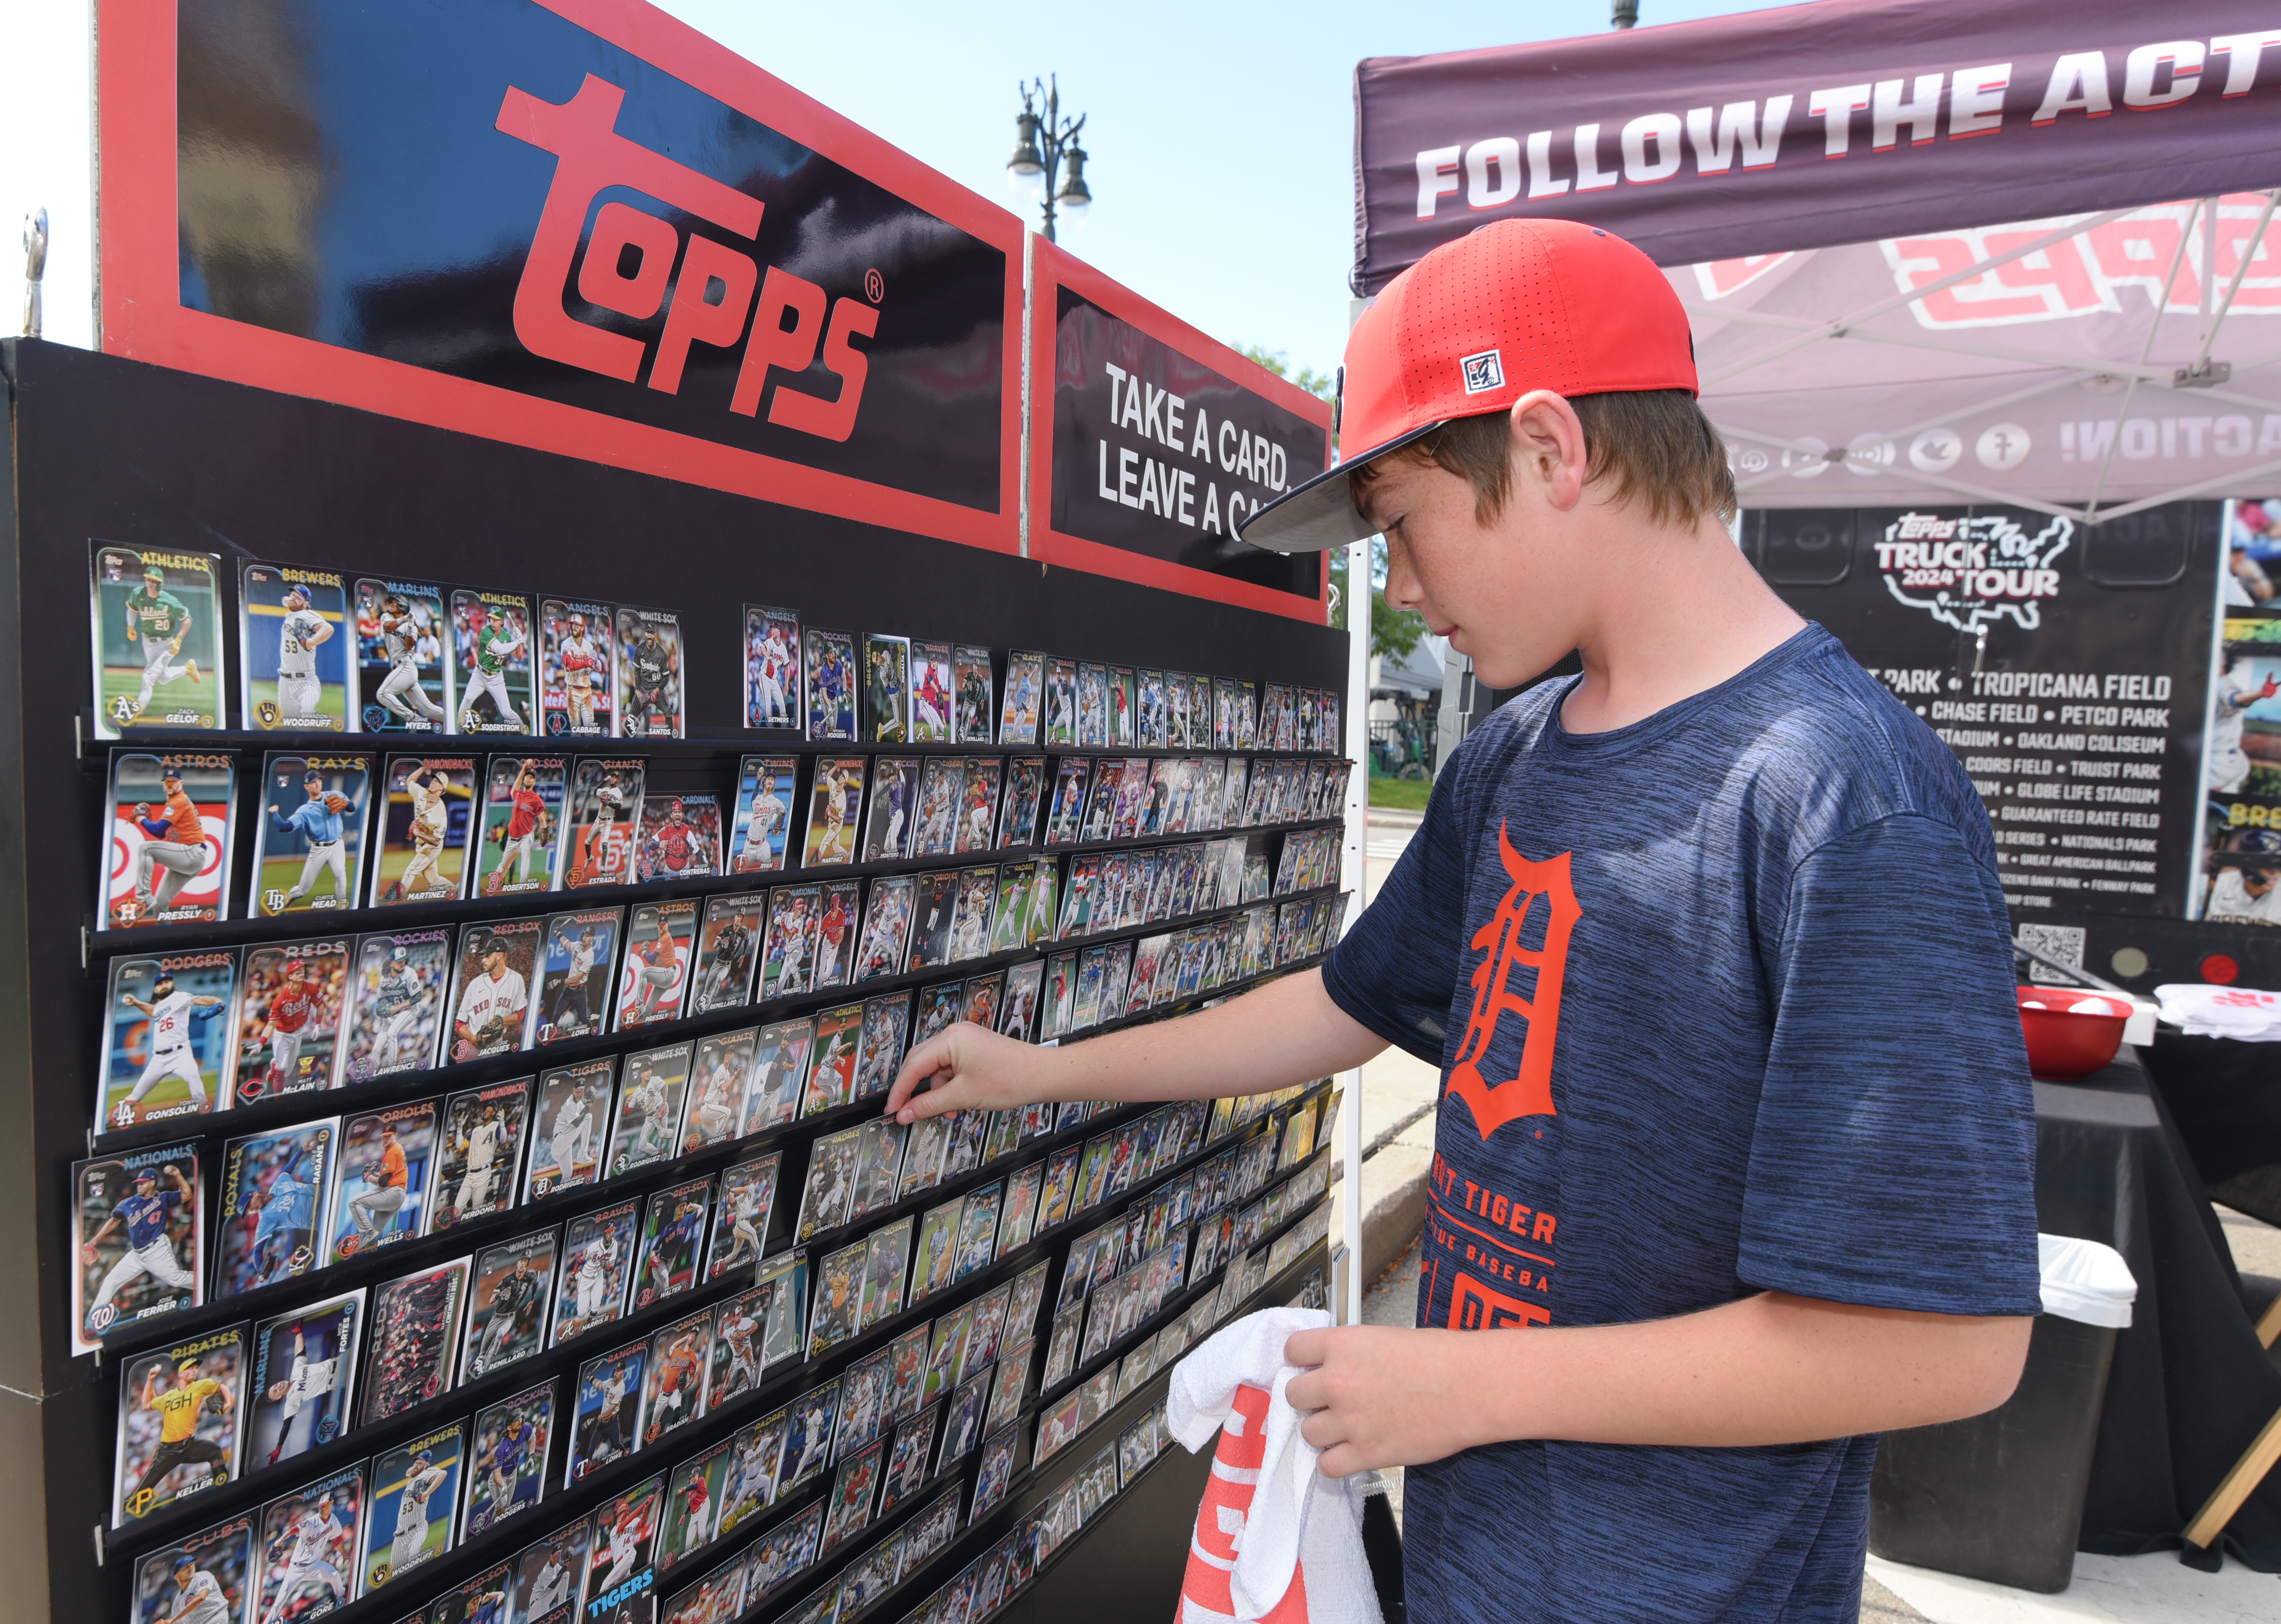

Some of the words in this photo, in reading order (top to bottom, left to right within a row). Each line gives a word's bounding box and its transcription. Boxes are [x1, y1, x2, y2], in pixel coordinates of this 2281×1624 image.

[1416, 95, 1793, 221] FOLLOW
[1809, 63, 2012, 160] THE
[1106, 362, 1184, 452] TAKE
[1192, 408, 1211, 463] A
[1100, 439, 1195, 527] LEAVE
[1202, 482, 1221, 535] A
[141, 551, 210, 571] ATHLETICS
[1874, 541, 1988, 571] TRUCK
[282, 568, 341, 587] BREWERS
[1902, 569, 1955, 588] 2024
[1956, 569, 2060, 599] TOUR
[387, 582, 439, 598] MARLINS
[480, 593, 526, 606] ATHLETICS
[568, 604, 609, 616] ANGELS
[767, 611, 796, 622] ANGELS
[824, 633, 851, 642] ROCKIES
[926, 644, 948, 653] BRAVES
[1971, 671, 2099, 698] TROPICANA
[2104, 674, 2172, 701] FIELD
[166, 714, 199, 723] GELOF
[1932, 701, 1988, 722] CHASE
[1990, 704, 2039, 723] FIELD
[2060, 706, 2119, 726] PETCO
[2121, 707, 2170, 728] PARK
[283, 718, 332, 728] WOODRUFF
[481, 723, 519, 731] SODERSTROM
[1936, 728, 1999, 748] STADIUM
[2018, 733, 2086, 752] OAKLAND
[2088, 735, 2165, 753] COLISEUM
[161, 755, 229, 768] ASTROS
[307, 758, 366, 770] RAYS
[423, 759, 473, 769] DIAMONDBACKS
[603, 760, 643, 769] GIANTS
[765, 760, 794, 768] TWINS
[1966, 757, 2012, 773] COORS
[2013, 759, 2053, 775] FIELD
[2070, 761, 2121, 778] TRUIST
[2123, 762, 2162, 780] PARK
[681, 795, 715, 804] CARDINALS
[2018, 781, 2062, 799] GLOBE
[2064, 783, 2094, 801] LIFE
[2096, 785, 2159, 804] STADIUM
[2001, 806, 2083, 825] GUARANTEED
[2086, 809, 2120, 826] RATE
[2121, 810, 2159, 829] FIELD
[2009, 831, 2045, 846] SERIES
[2062, 835, 2124, 851] NATIONALS
[2125, 836, 2157, 853] PARK
[1015, 863, 1034, 872] PADRES
[589, 877, 616, 885] ESTRADA
[935, 873, 958, 881] ORIOLES
[502, 882, 539, 891] ROBERTSON
[791, 887, 821, 897] NATIONALS
[407, 891, 445, 900] MARTINEZ
[729, 897, 747, 906] WHITE
[311, 900, 336, 909] MEAD
[658, 903, 695, 915] ASTROS
[158, 910, 202, 921] PRESSLY
[577, 912, 618, 924] RANGERS
[493, 924, 517, 936] RED
[519, 922, 540, 933] SOX
[394, 930, 446, 945] ROCKIES
[286, 942, 346, 958] REDS
[161, 954, 230, 971] DODGERS
[781, 986, 802, 995] MENESES
[710, 999, 737, 1010] REMILLARD
[160, 1017, 173, 1032] 26
[645, 1013, 669, 1022] PRESSLY
[572, 1028, 590, 1037] LOWE
[721, 1032, 754, 1046] GIANTS
[478, 1044, 509, 1056] JACQUES
[653, 1049, 673, 1061] WHITE
[675, 1046, 688, 1057] SOX
[373, 1062, 416, 1076] LAWRENCE
[572, 1062, 611, 1077] TIGERS
[282, 1082, 315, 1095] McLAIN
[480, 1083, 526, 1102] DIAMONDBACKS
[146, 1104, 199, 1121] GONSOLIN
[382, 1103, 433, 1123] ORIOLES
[766, 1117, 783, 1127] JANSEN
[707, 1134, 726, 1145] ROGERS
[124, 1145, 193, 1170] NATIONALS
[313, 1145, 324, 1183] RAGANS
[746, 1157, 777, 1172] TWINS
[224, 1149, 242, 1216] ROYALS
[550, 1177, 585, 1193] RODRIGUEZ
[461, 1204, 496, 1221] PERDOMO
[474, 1201, 494, 1210] GERALDO
[595, 1203, 635, 1224] BRAVES
[1465, 1180, 1556, 1244] TIGER
[377, 1233, 403, 1247] WELLS
[509, 1237, 534, 1253] WHITE
[536, 1232, 554, 1245] SOX
[726, 1257, 750, 1271] KIRILLOFF
[660, 1286, 681, 1299] WALTER
[136, 1301, 176, 1320] FERRER
[339, 1317, 350, 1353] FORTES
[171, 1329, 240, 1361] PIRATES
[608, 1340, 647, 1364] RANGERS
[255, 1330, 271, 1394] MARLINS
[488, 1351, 526, 1371] REMILLARD
[507, 1385, 551, 1410] ROCKIES
[723, 1385, 749, 1402] WESTBURG
[165, 1393, 192, 1412] PGH
[665, 1416, 688, 1433] BRADISH
[409, 1426, 460, 1455] BREWERS
[192, 1475, 210, 1485] MITCH
[303, 1469, 359, 1502] NATIONALS
[176, 1479, 213, 1499] KELLER
[494, 1502, 526, 1524] RODGERS
[183, 1517, 249, 1554] CUBS
[677, 1541, 702, 1561] VERDUGO
[392, 1551, 434, 1578] WOODRUFF
[588, 1568, 653, 1618] TIGERS
[310, 1603, 334, 1620] GORE
